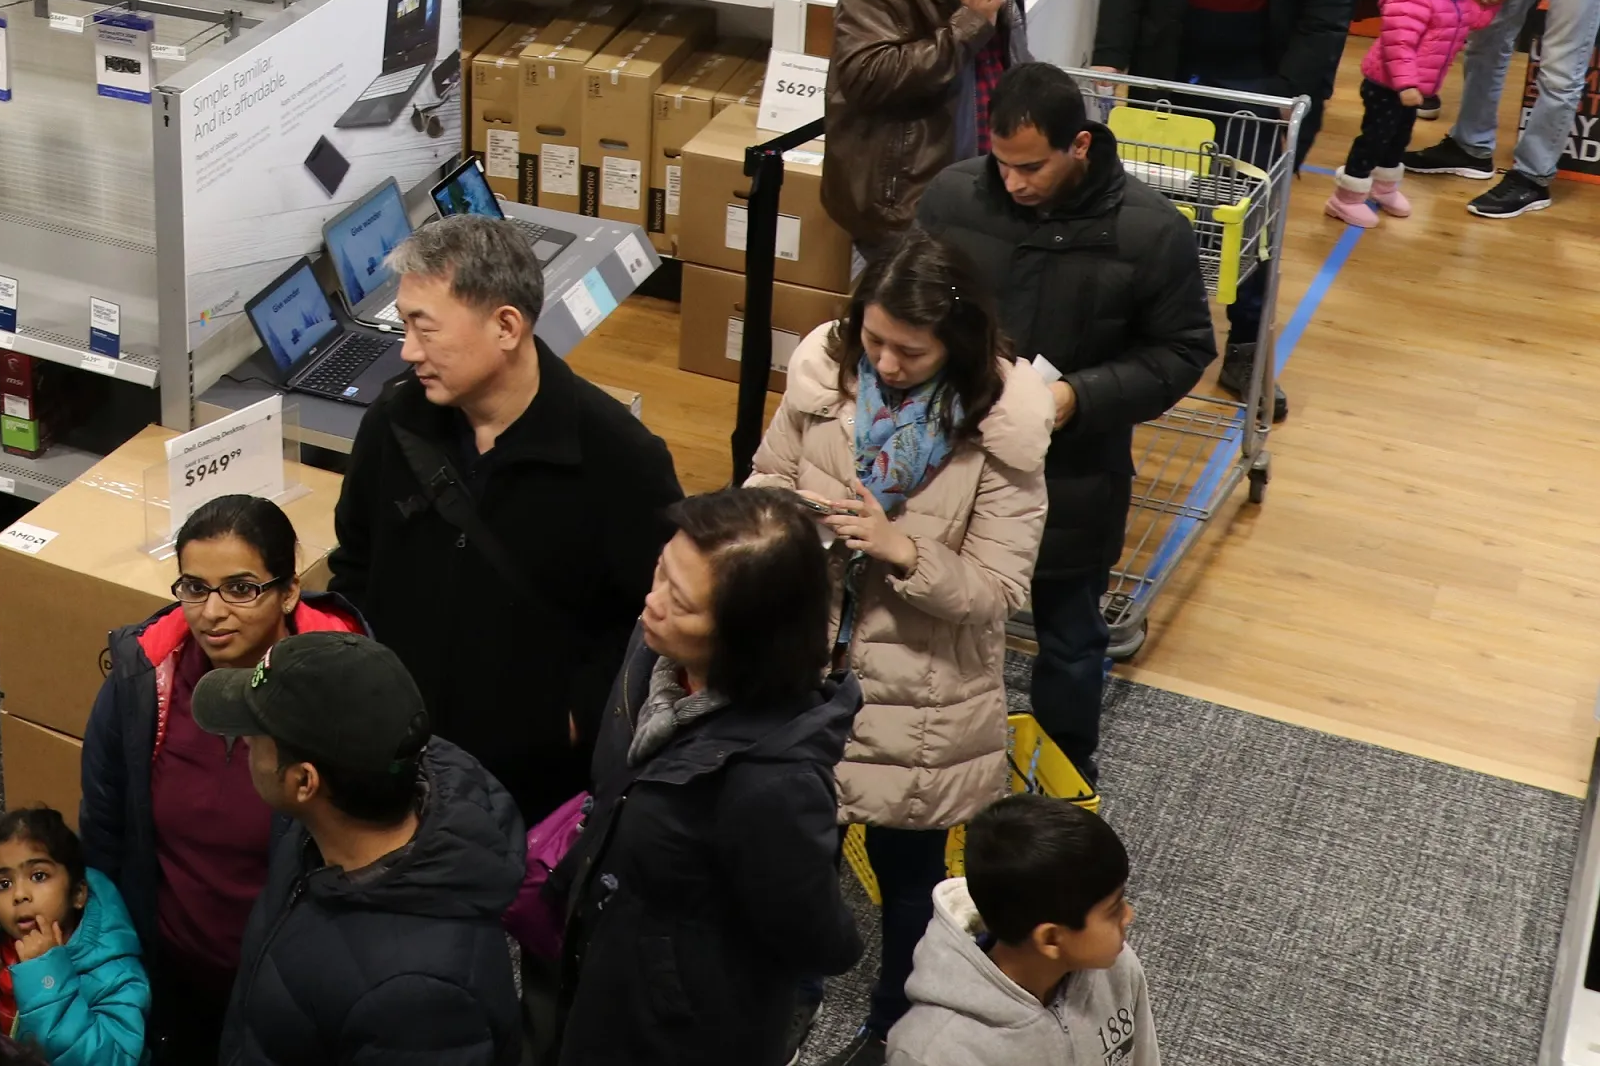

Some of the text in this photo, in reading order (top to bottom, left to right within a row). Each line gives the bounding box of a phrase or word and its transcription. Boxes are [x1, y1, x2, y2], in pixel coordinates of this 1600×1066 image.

[193, 55, 274, 118] Simple. Familiar.
[193, 73, 287, 142] And it's affordable.
[527, 157, 537, 206] deacentre
[585, 170, 596, 217] deacentre
[350, 210, 382, 238] Give wonder
[272, 287, 299, 314] Give wonder
[183, 423, 247, 454] Dell Gaming Desktop
[7, 529, 37, 542] AMD
